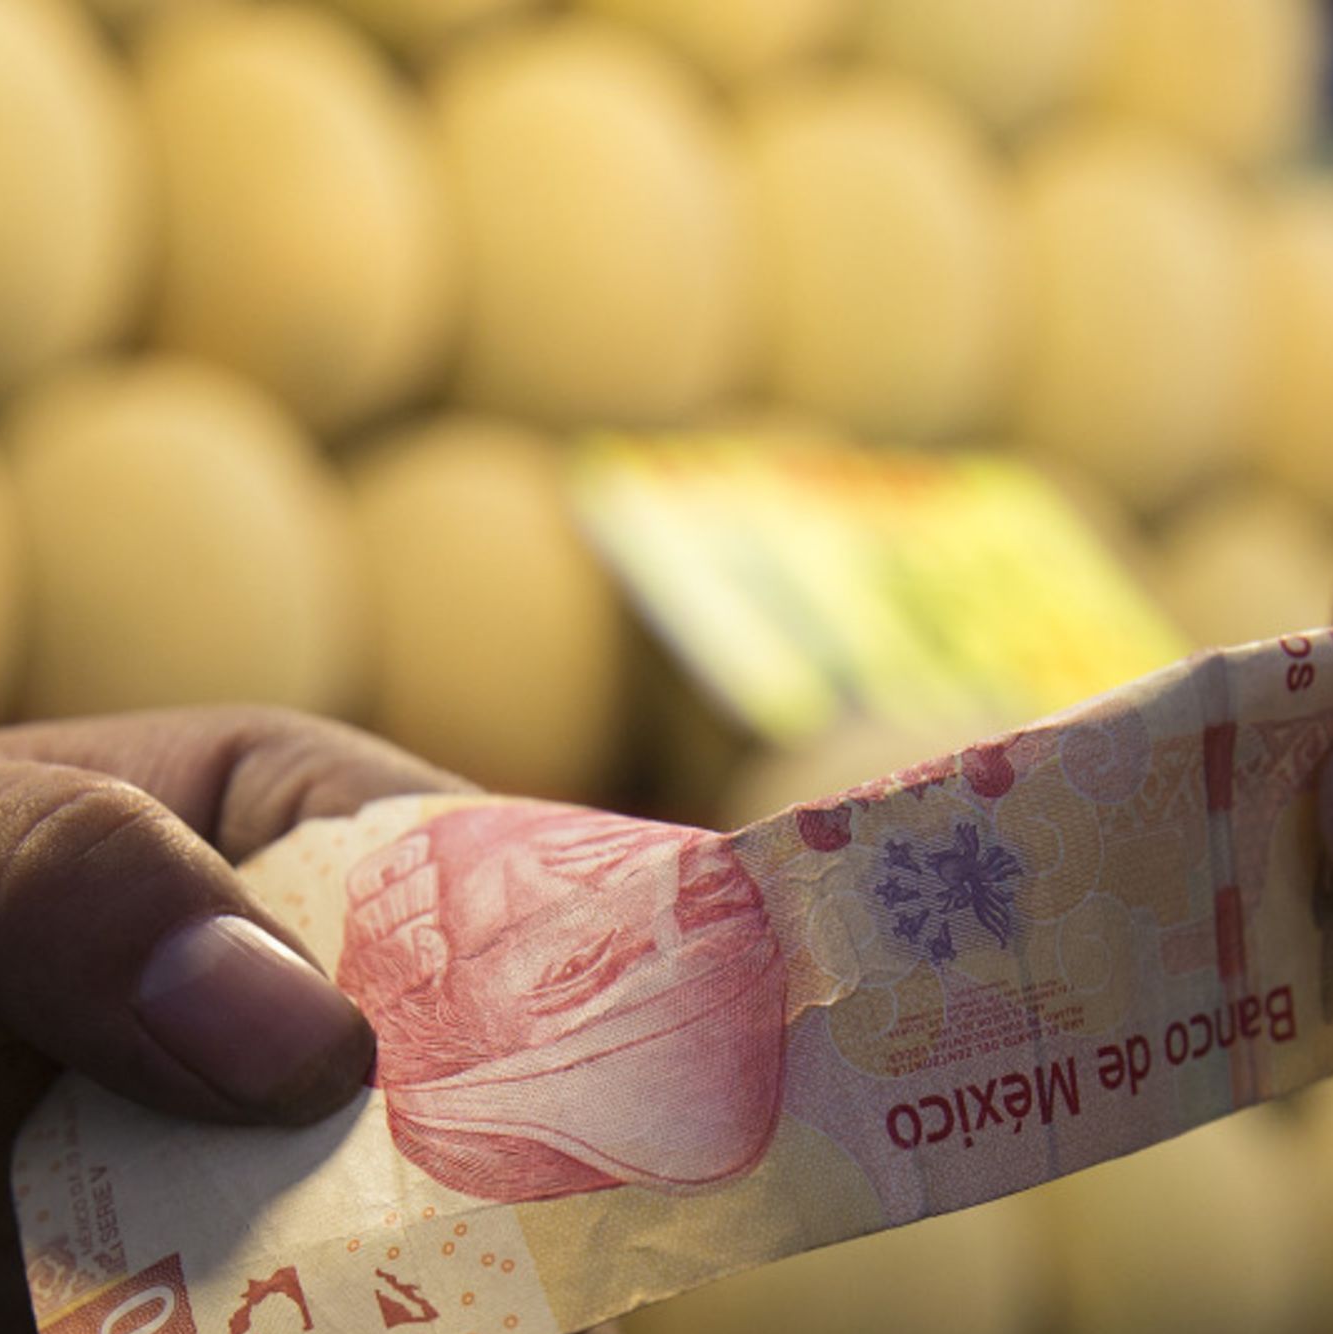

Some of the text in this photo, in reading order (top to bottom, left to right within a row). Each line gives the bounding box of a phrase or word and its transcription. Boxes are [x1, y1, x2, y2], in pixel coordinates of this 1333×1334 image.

[1097, 1034, 1152, 1096] de
[1166, 985, 1298, 1067] Banco
[885, 1055, 1081, 1150] México
